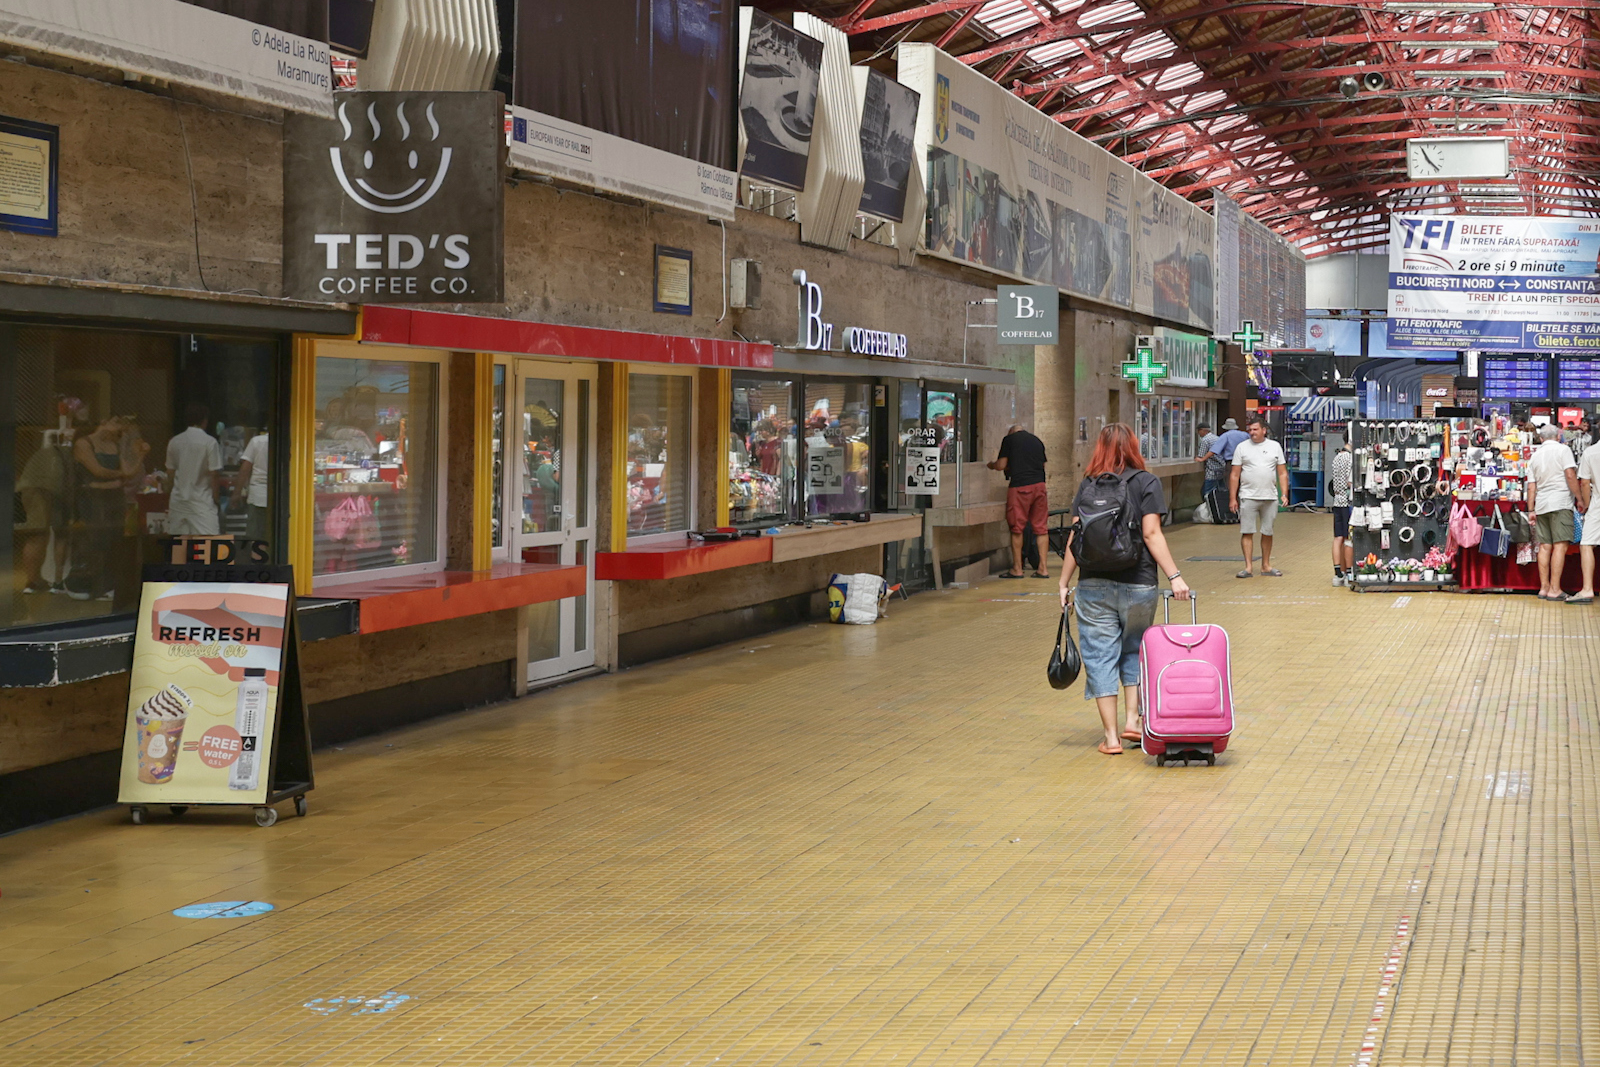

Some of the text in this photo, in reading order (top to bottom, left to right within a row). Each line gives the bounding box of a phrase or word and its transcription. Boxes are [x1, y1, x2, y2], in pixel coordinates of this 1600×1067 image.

[263, 32, 290, 54] Adela
[293, 40, 305, 58] Lia
[308, 45, 328, 65] Rusu
[277, 60, 328, 92] Maramureș
[530, 129, 591, 154] EUROPEAN YEAR OF RAIL 2021
[1400, 219, 1503, 251] TFI BILETE
[1578, 224, 1592, 232] DIN
[1460, 235, 1580, 247] ÎN TREN FĂRĂ SUPRATAXĂ!
[314, 234, 470, 270] TED'S
[1406, 264, 1439, 272] FEROTRAFIC
[1458, 260, 1565, 274] 2 ore și 9 minute
[318, 277, 475, 294] COFFEE CO.
[1396, 276, 1596, 293] BUCUREȘTI NORD CONSTANȚA
[1468, 293, 1495, 302] TREN
[1498, 293, 1508, 302] IC
[1511, 294, 1523, 303] LA
[1525, 295, 1538, 303] UN
[1540, 295, 1564, 304] PREȚ
[1395, 319, 1463, 329] TFI FEROTRAFIC
[1526, 324, 1569, 333] BILETELE
[1570, 324, 1582, 333] SE
[850, 326, 907, 358] COFFEELAB
[1001, 330, 1053, 338] COFFEELAB
[1163, 336, 1207, 380] FARMACIE
[907, 427, 936, 437] ORAR
[159, 539, 270, 565] TED'S
[163, 569, 234, 582] COFFEE
[159, 626, 261, 642] REFRESH
[223, 643, 248, 659] on
[170, 684, 193, 707] Frappe XL
[202, 735, 240, 751] FREE
[203, 748, 234, 761] water
